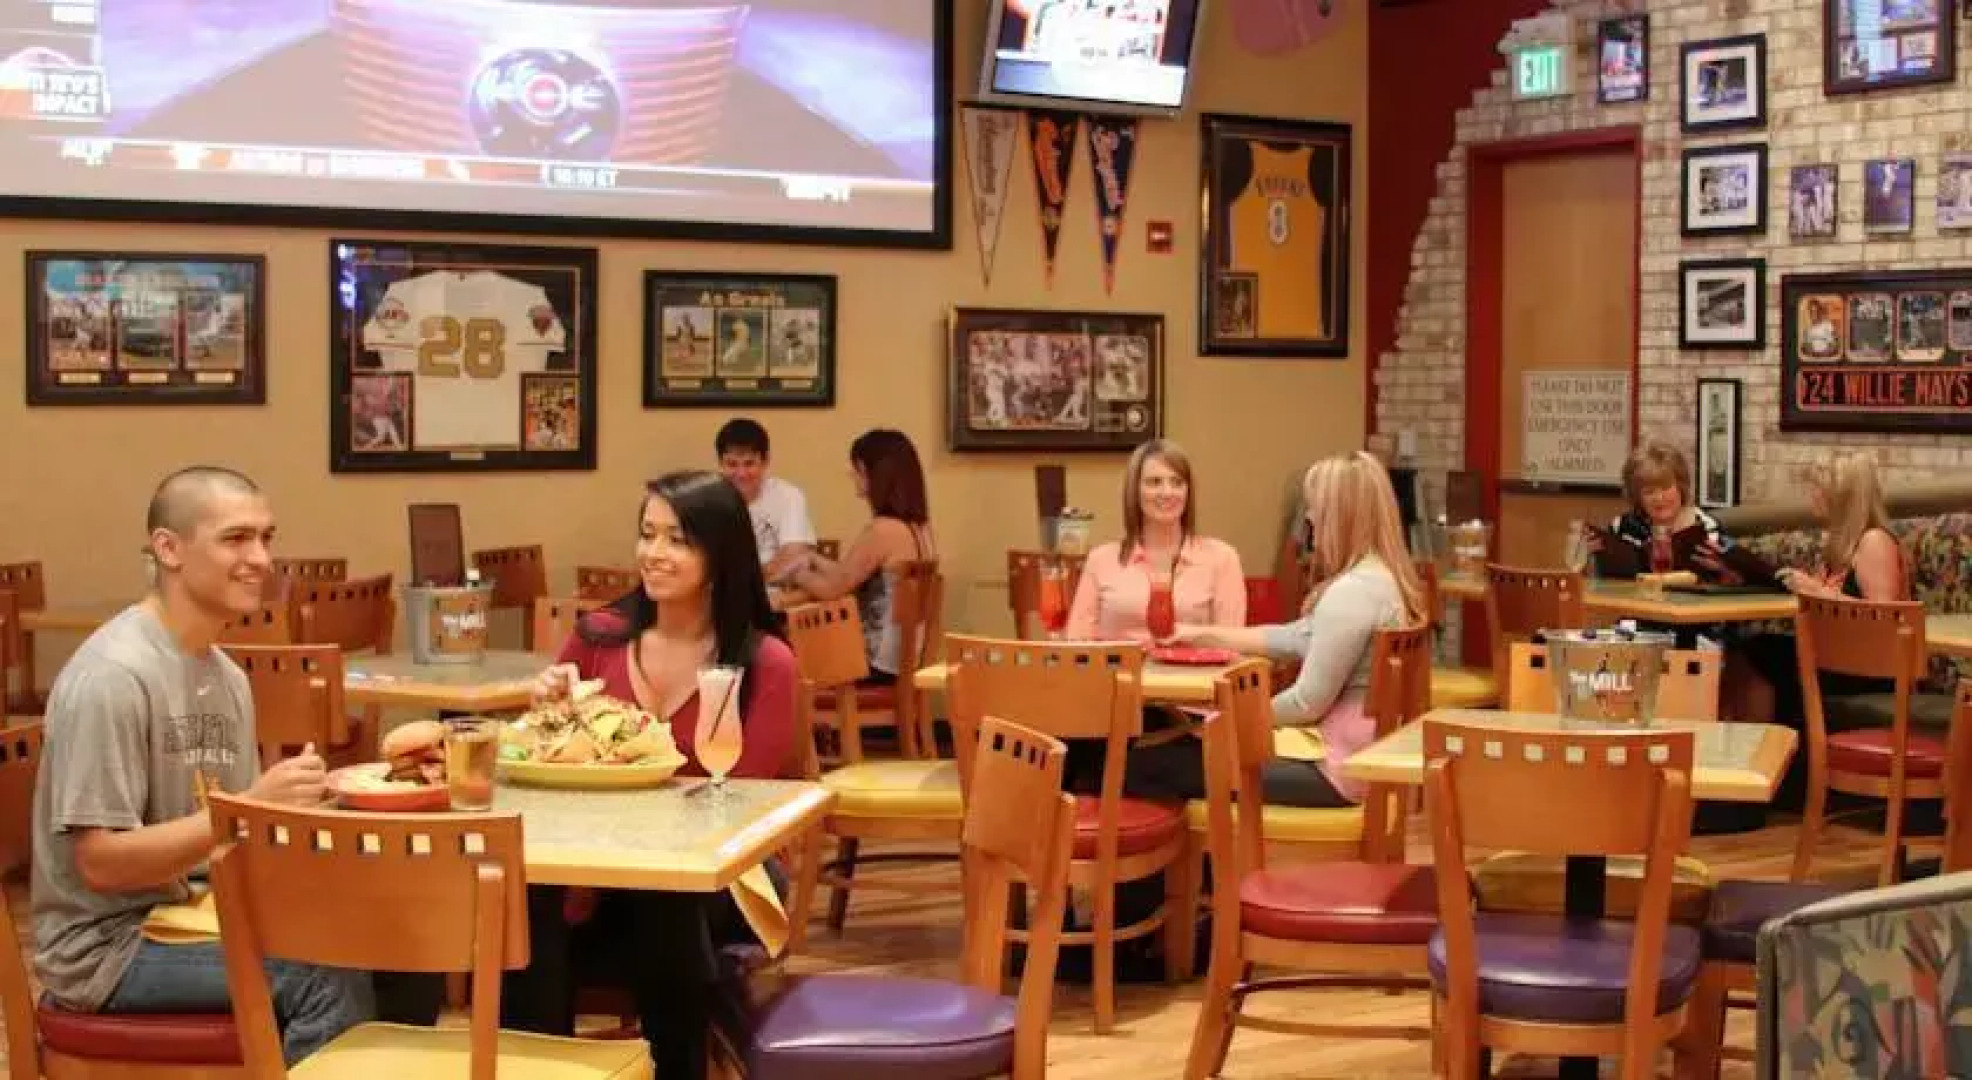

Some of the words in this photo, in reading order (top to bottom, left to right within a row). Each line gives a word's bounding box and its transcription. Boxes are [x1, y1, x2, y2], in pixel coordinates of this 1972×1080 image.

[1519, 51, 1560, 94] EXIT
[1268, 199, 1288, 245] 8
[417, 315, 506, 380] 28
[1809, 373, 1834, 404] 24
[1844, 373, 1905, 404] WILLIE
[1915, 374, 1969, 407] MAYS
[1589, 672, 1634, 692] MILL
